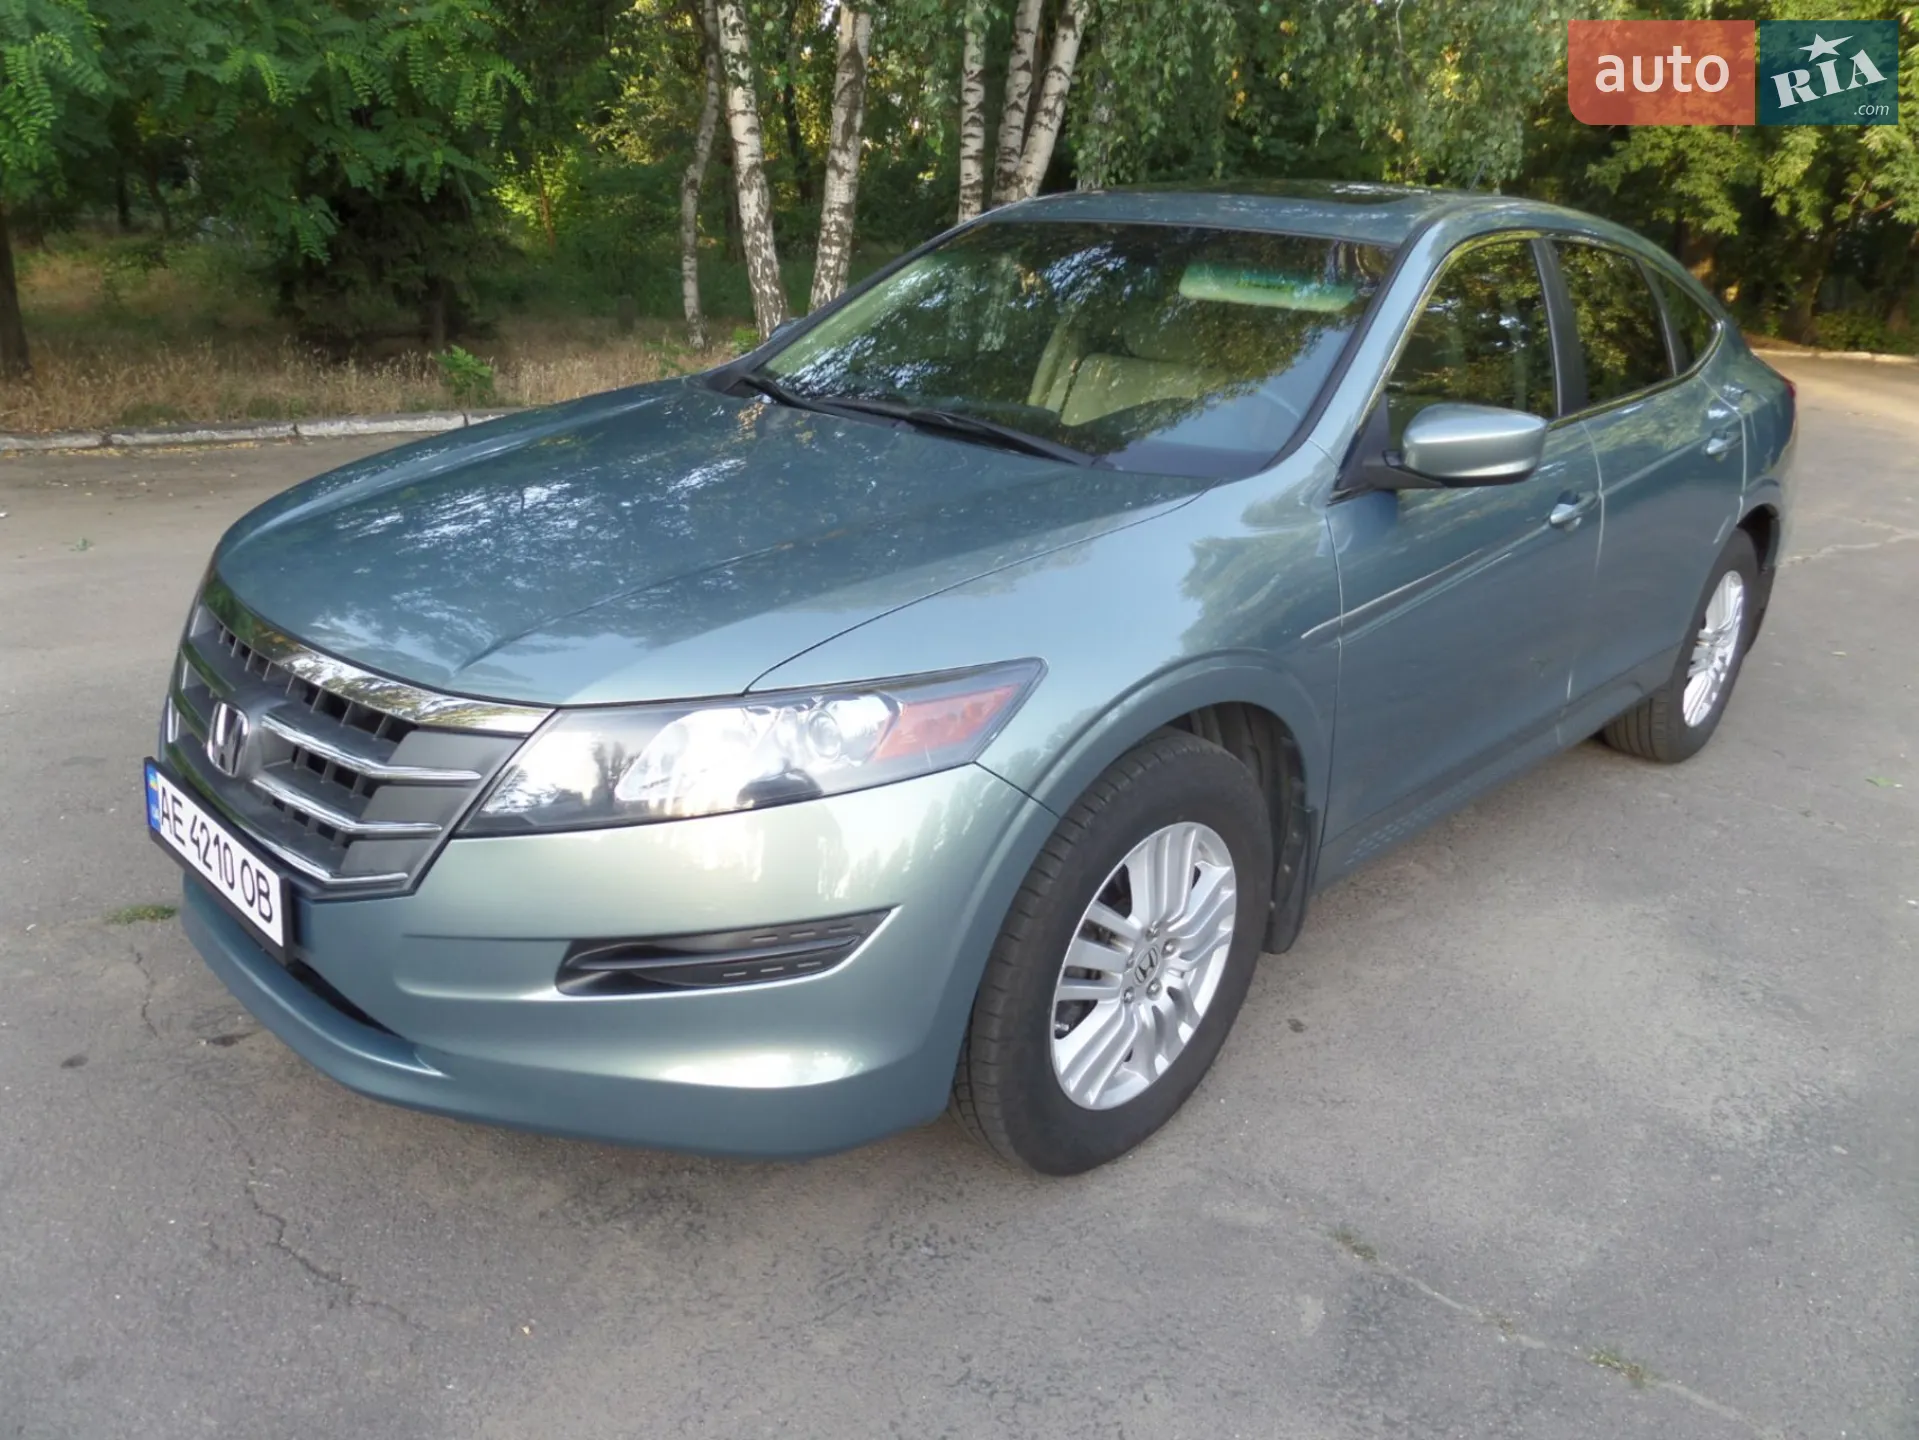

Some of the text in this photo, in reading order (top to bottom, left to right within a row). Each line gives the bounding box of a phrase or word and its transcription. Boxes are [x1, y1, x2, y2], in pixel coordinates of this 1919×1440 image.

[160, 787, 273, 924] AE 4210 OB
